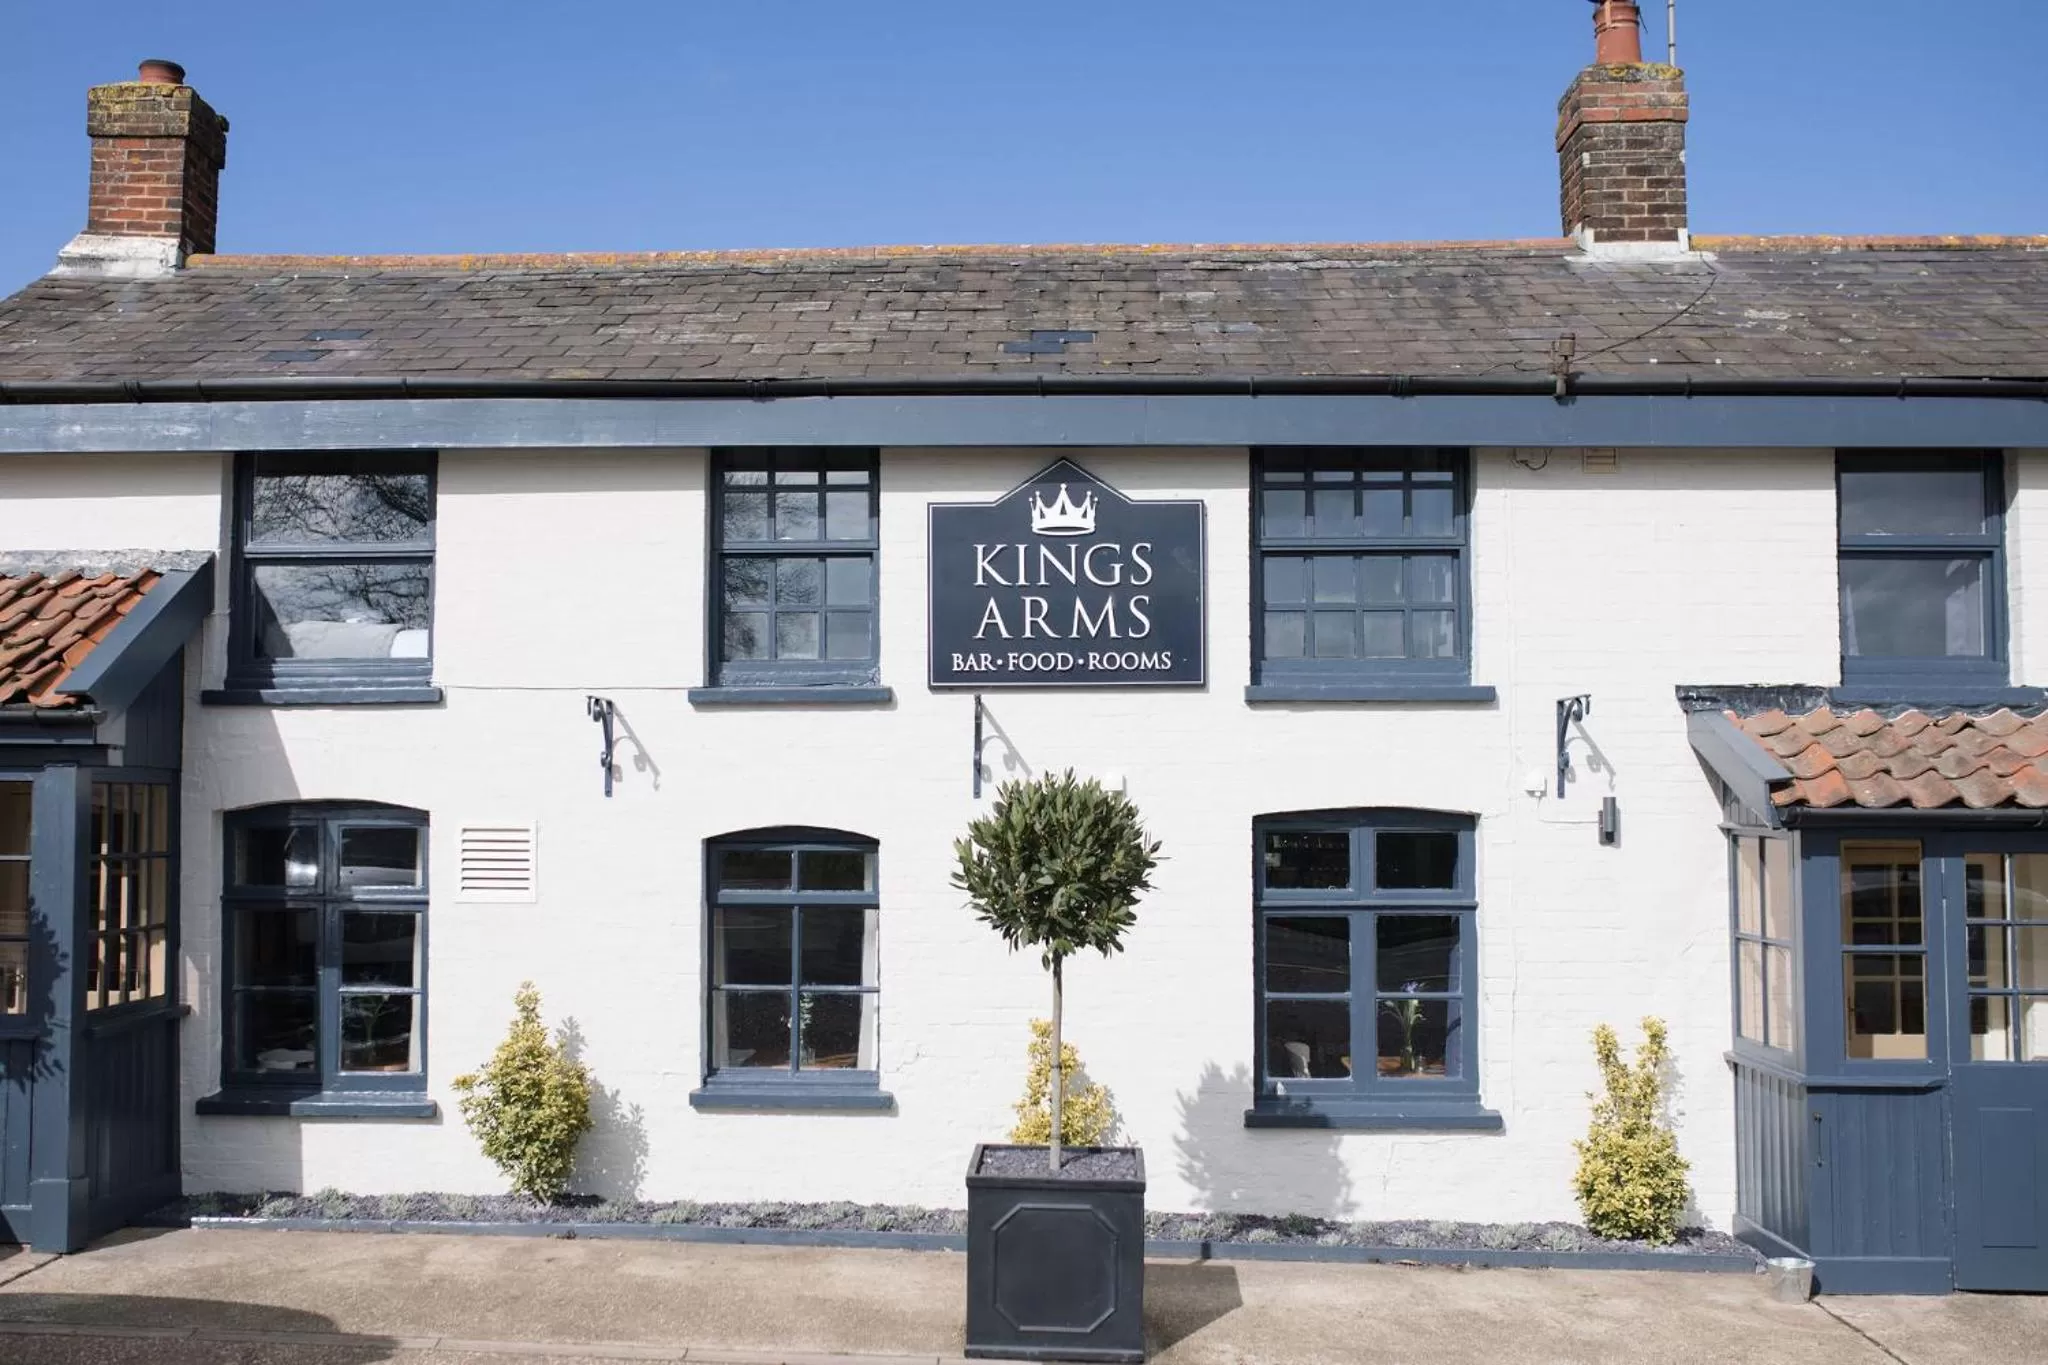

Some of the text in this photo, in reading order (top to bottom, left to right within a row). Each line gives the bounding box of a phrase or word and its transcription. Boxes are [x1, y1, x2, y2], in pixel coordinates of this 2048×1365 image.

[973, 543, 1153, 586] KINGS
[973, 595, 1151, 639] ARMS
[951, 651, 1172, 671] BAR FOOD ROOMS
